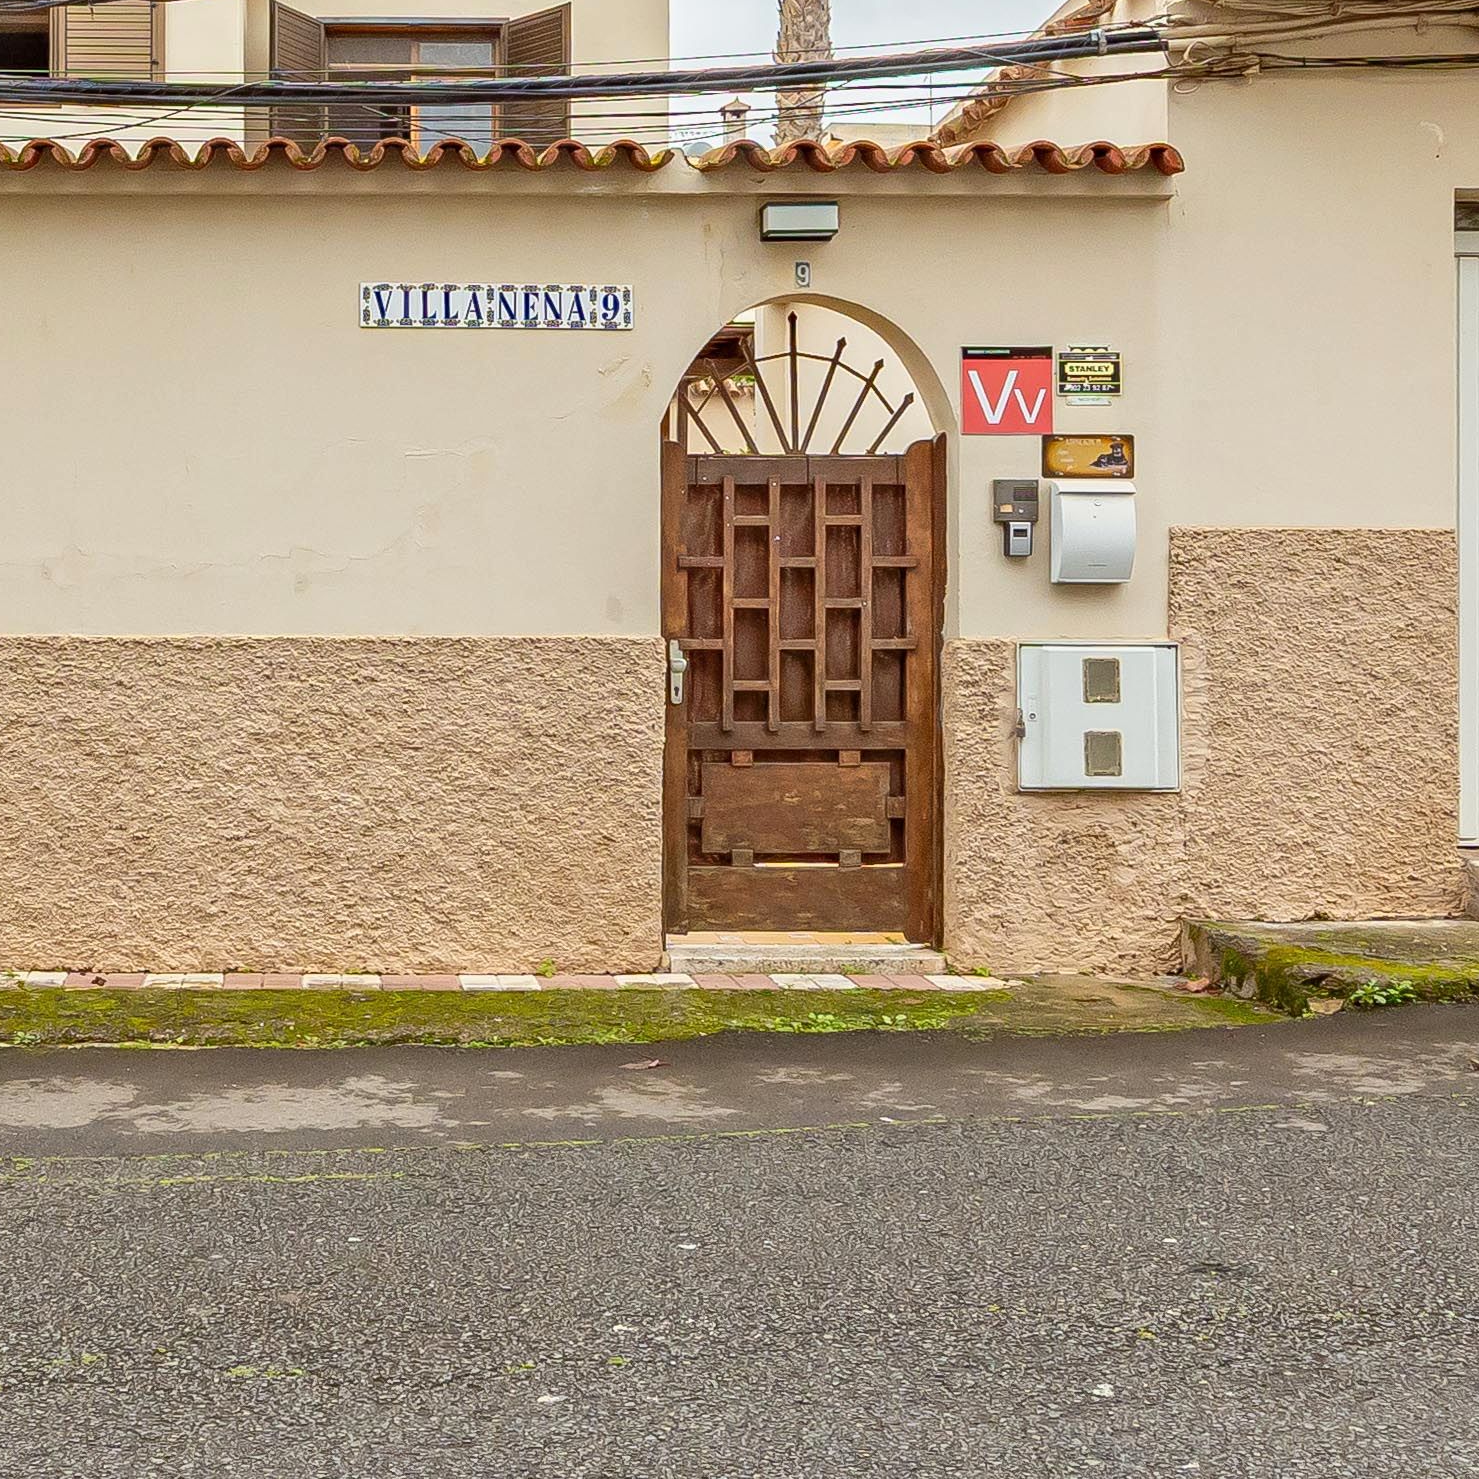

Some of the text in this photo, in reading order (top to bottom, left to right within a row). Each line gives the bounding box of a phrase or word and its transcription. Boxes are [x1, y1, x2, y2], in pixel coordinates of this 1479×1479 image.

[796, 264, 810, 286] 9
[373, 289, 484, 321] VILLA
[601, 292, 621, 322] 9
[1068, 365, 1110, 373] STANLEY
